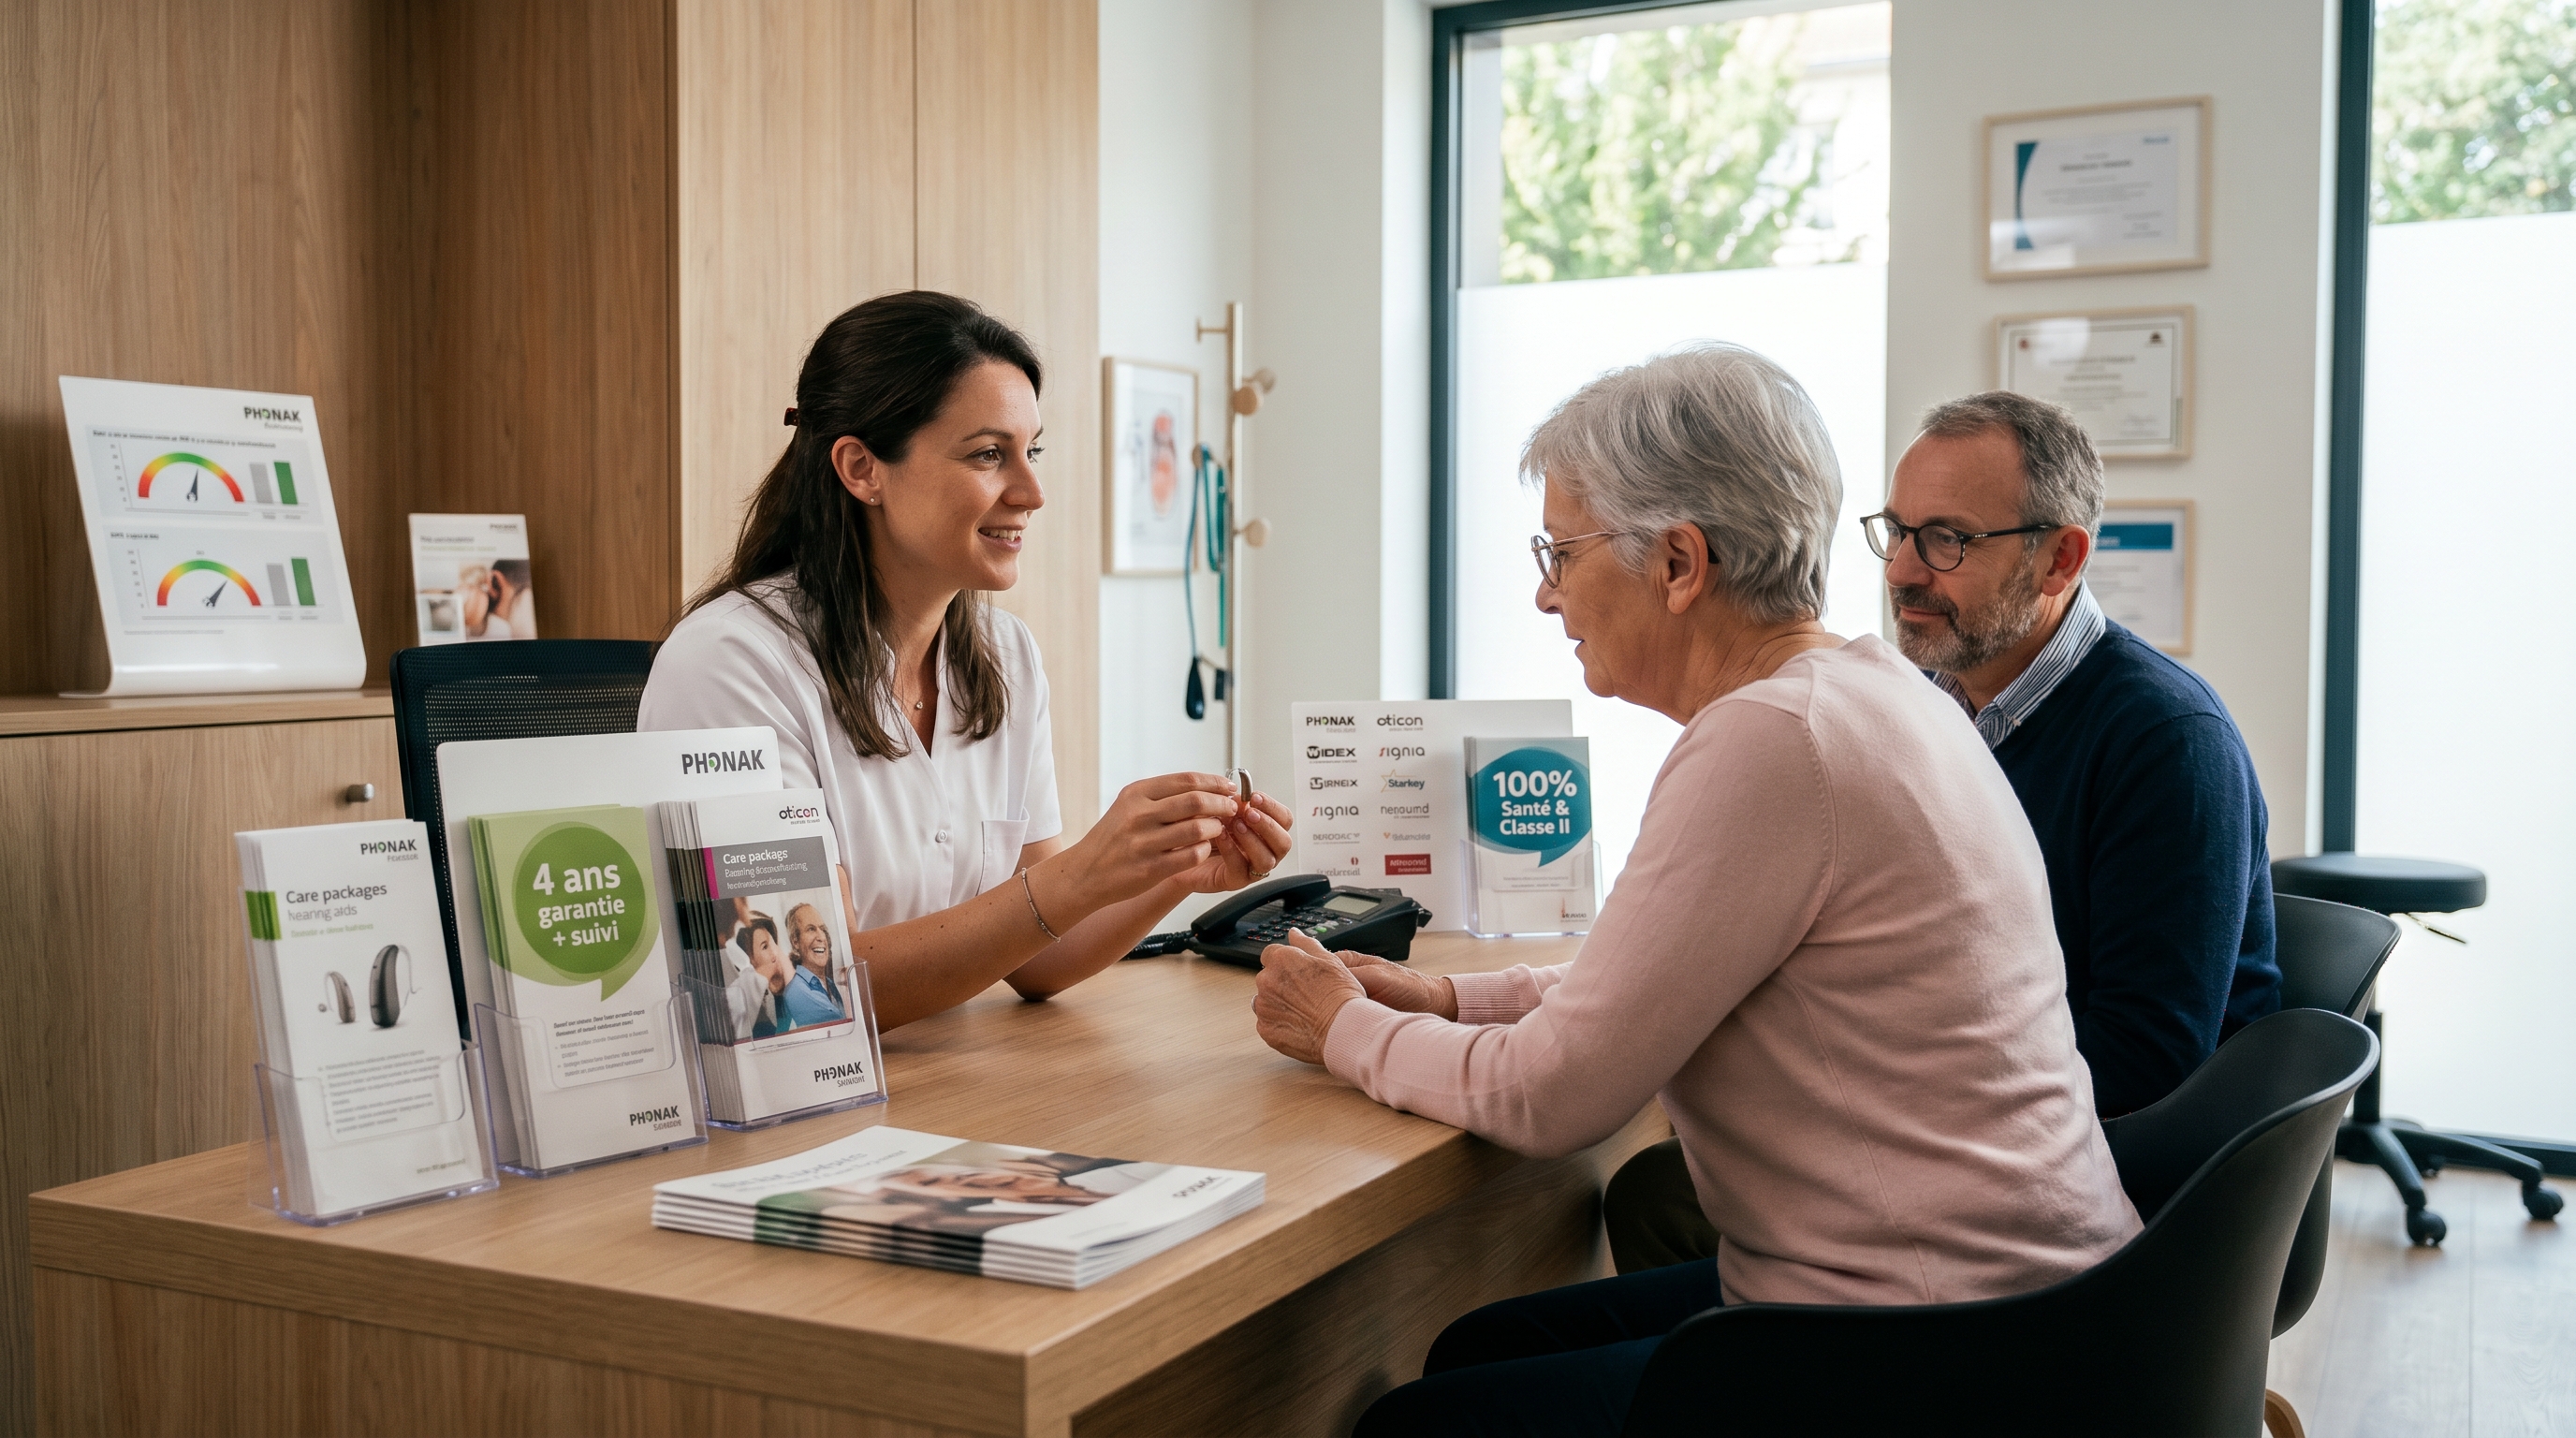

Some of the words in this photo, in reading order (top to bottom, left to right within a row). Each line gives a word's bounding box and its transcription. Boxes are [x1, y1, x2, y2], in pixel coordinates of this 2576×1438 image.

[243, 406, 301, 422] PHONAK
[1306, 716, 1354, 726] PHONAK
[1377, 714, 1423, 726] oticon
[1307, 745, 1356, 759] WIDEX
[1379, 746, 1426, 760] signia
[681, 749, 765, 774] PHONAK
[1388, 778, 1426, 790] Starkey
[1493, 770, 1577, 798] 100%
[779, 805, 819, 820] oticon
[1312, 806, 1359, 820] signia
[1500, 799, 1551, 817] Santé
[1555, 800, 1571, 816] &
[1500, 819, 1555, 835] Classe
[360, 839, 417, 855] PHONAK
[723, 853, 747, 865] Care
[533, 862, 555, 896] 4
[564, 863, 622, 893] ans
[285, 890, 319, 904] Care
[323, 885, 388, 905] packages
[537, 896, 625, 930] garantie
[552, 931, 566, 946] +
[571, 920, 621, 946] suivi
[813, 1061, 864, 1083] PHONAK
[629, 1105, 680, 1126] PHONAK
